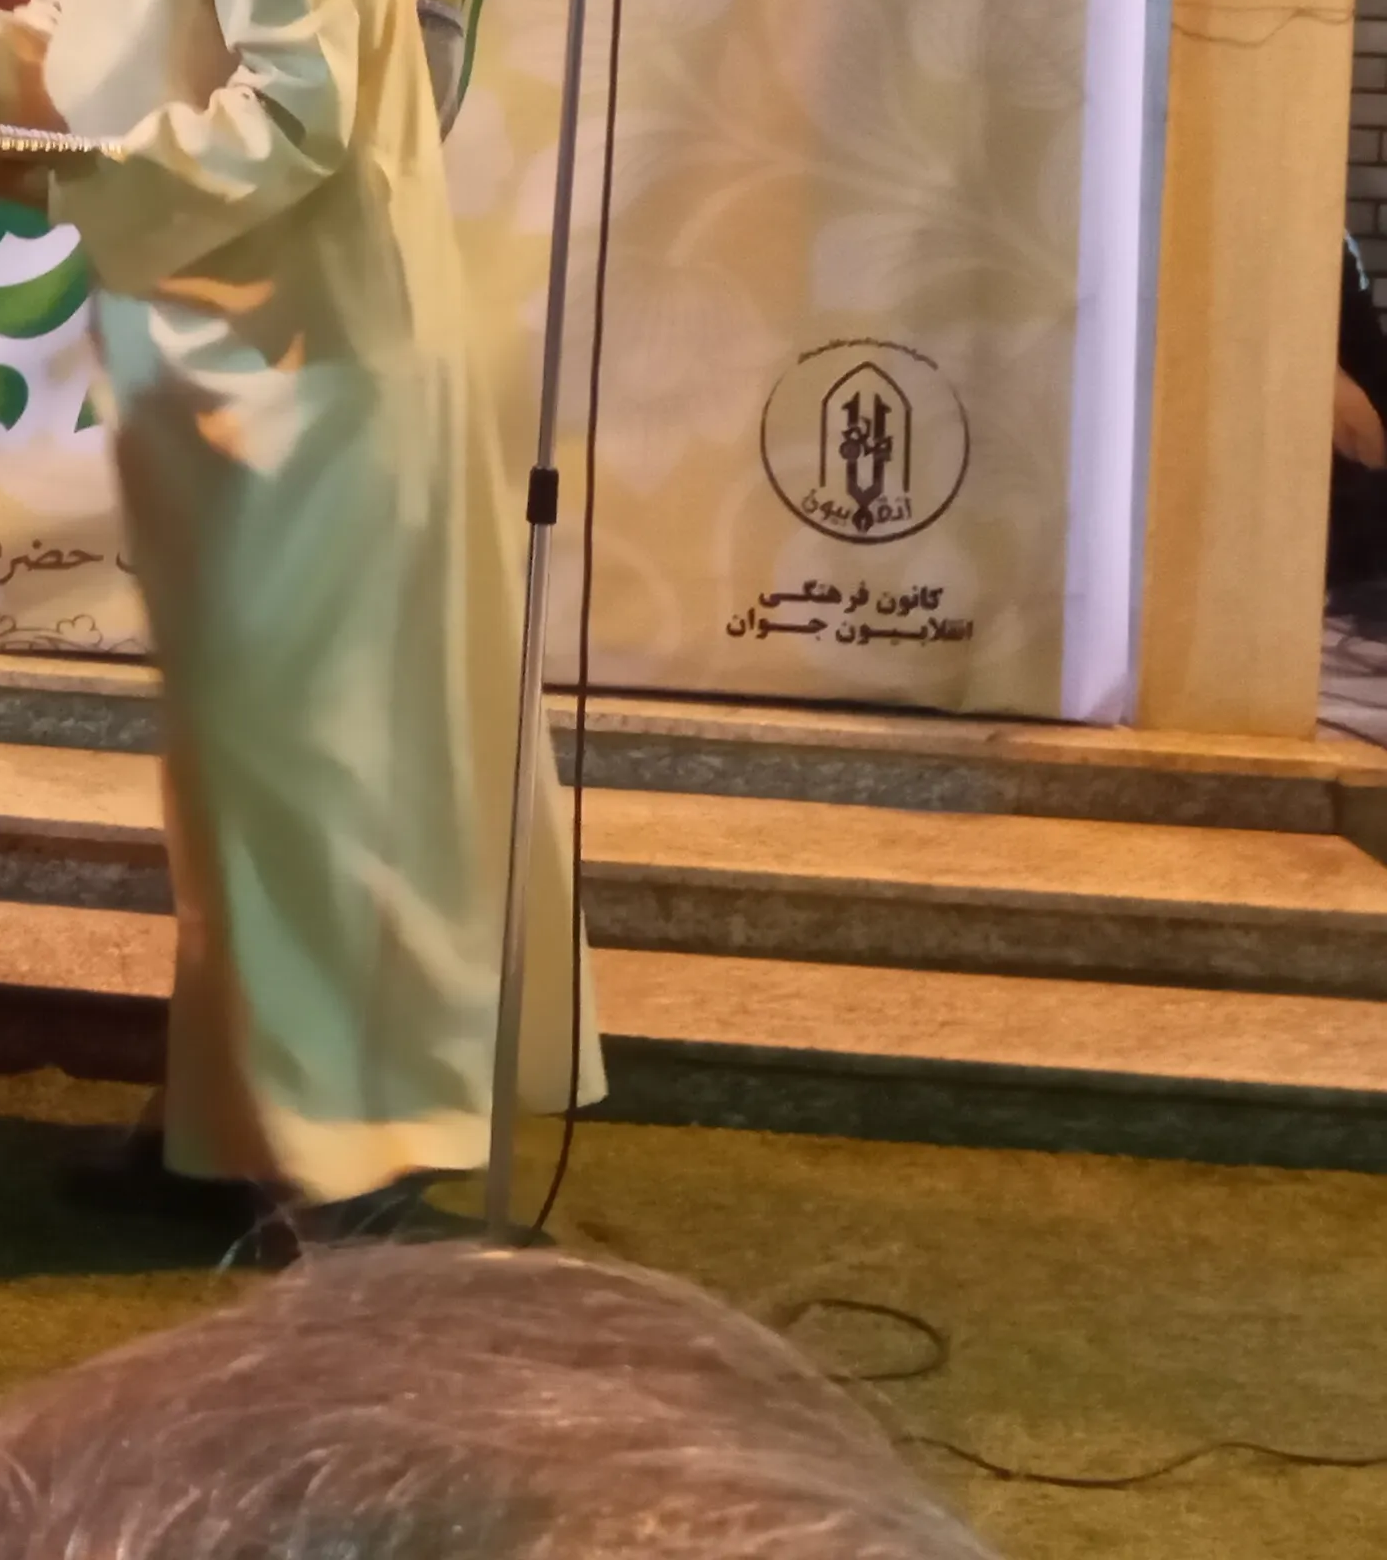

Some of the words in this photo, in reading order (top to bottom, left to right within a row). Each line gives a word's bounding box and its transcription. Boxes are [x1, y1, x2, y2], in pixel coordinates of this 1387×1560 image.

[758, 579, 870, 613] فرهنگی
[876, 585, 944, 617] کانون
[726, 607, 828, 641] جوان
